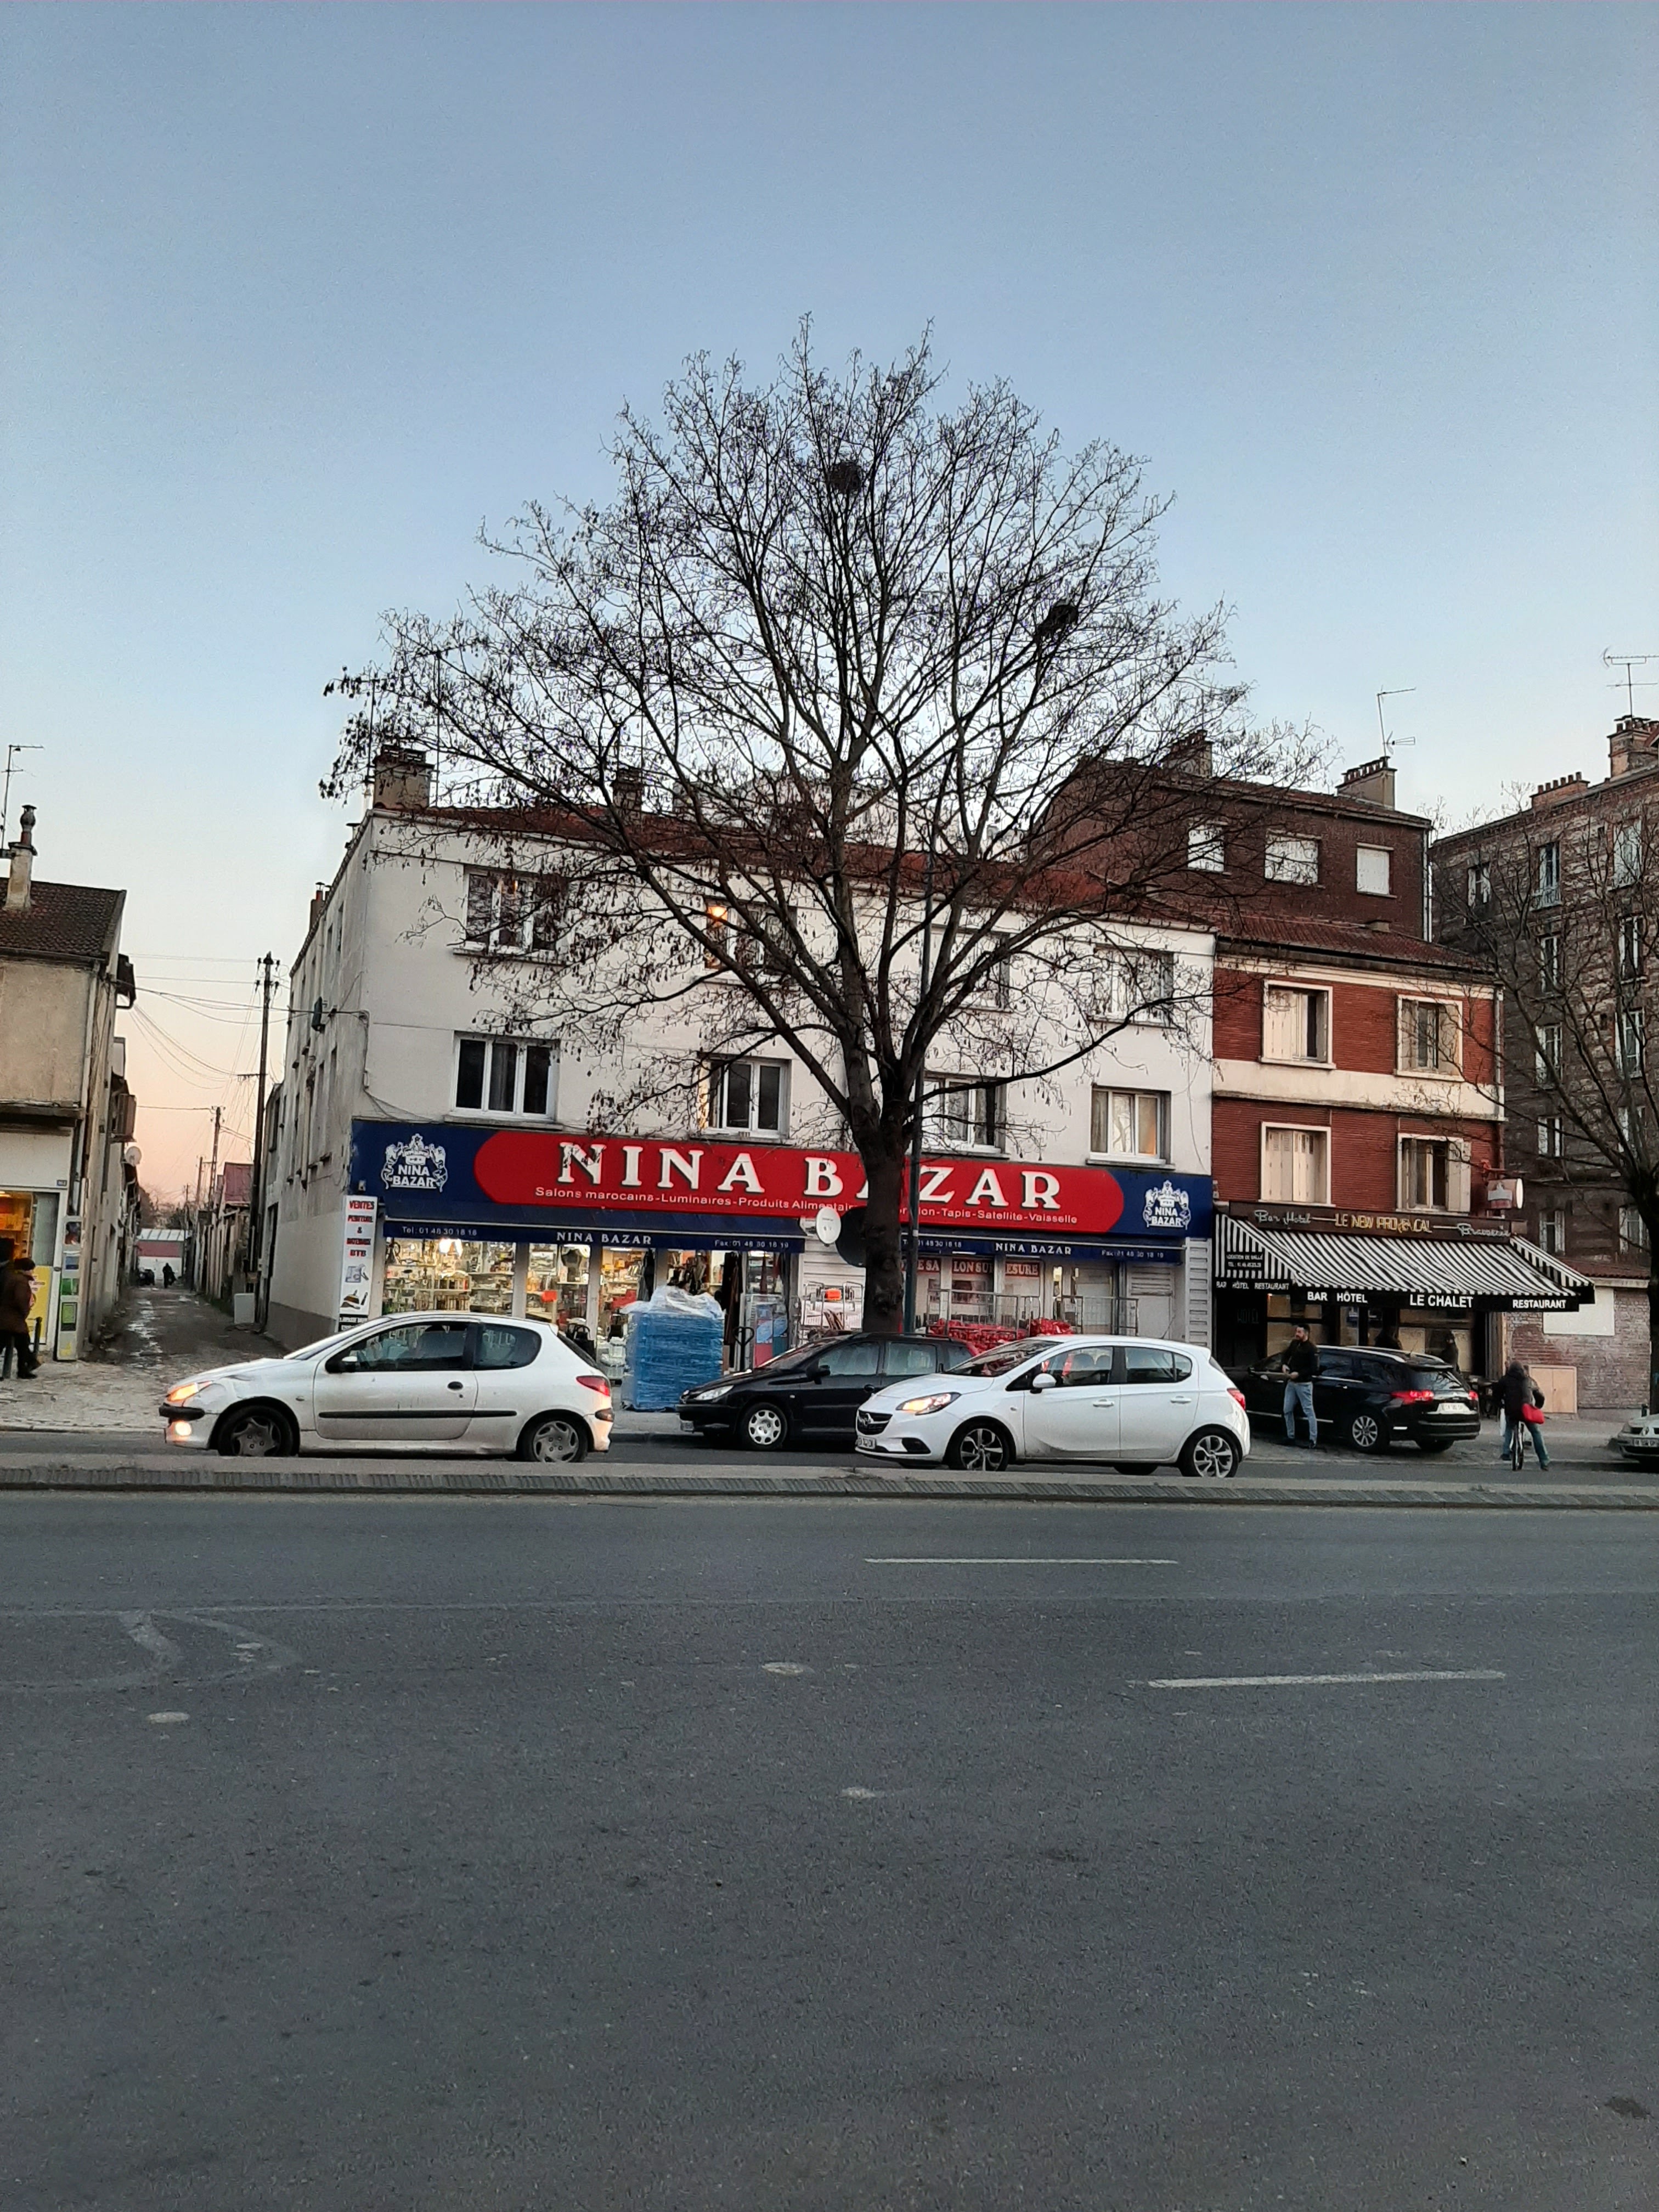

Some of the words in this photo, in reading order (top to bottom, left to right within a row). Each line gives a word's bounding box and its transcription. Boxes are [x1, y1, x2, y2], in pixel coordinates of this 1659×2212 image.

[398, 1164, 430, 1176] NINA
[557, 1142, 765, 1193] NINA
[393, 1176, 435, 1188] BAZAR
[535, 1187, 582, 1198] Salons
[1154, 1206, 1178, 1217] NINA
[1254, 1209, 1280, 1223] Bar
[1151, 1216, 1182, 1226] BAZAR
[1335, 1212, 1348, 1227] LE
[1351, 1214, 1374, 1228] NEW
[556, 1232, 594, 1243] NINA
[601, 1233, 652, 1245] BAZAR
[995, 1242, 1026, 1253] NINA
[1031, 1244, 1072, 1255] BAZAR
[1307, 1291, 1328, 1301] BAR
[1336, 1290, 1368, 1304] HÔTEL
[1409, 1294, 1425, 1306] LE
[1427, 1295, 1474, 1308] CHALET
[1513, 1299, 1567, 1309] RESTAURANT
